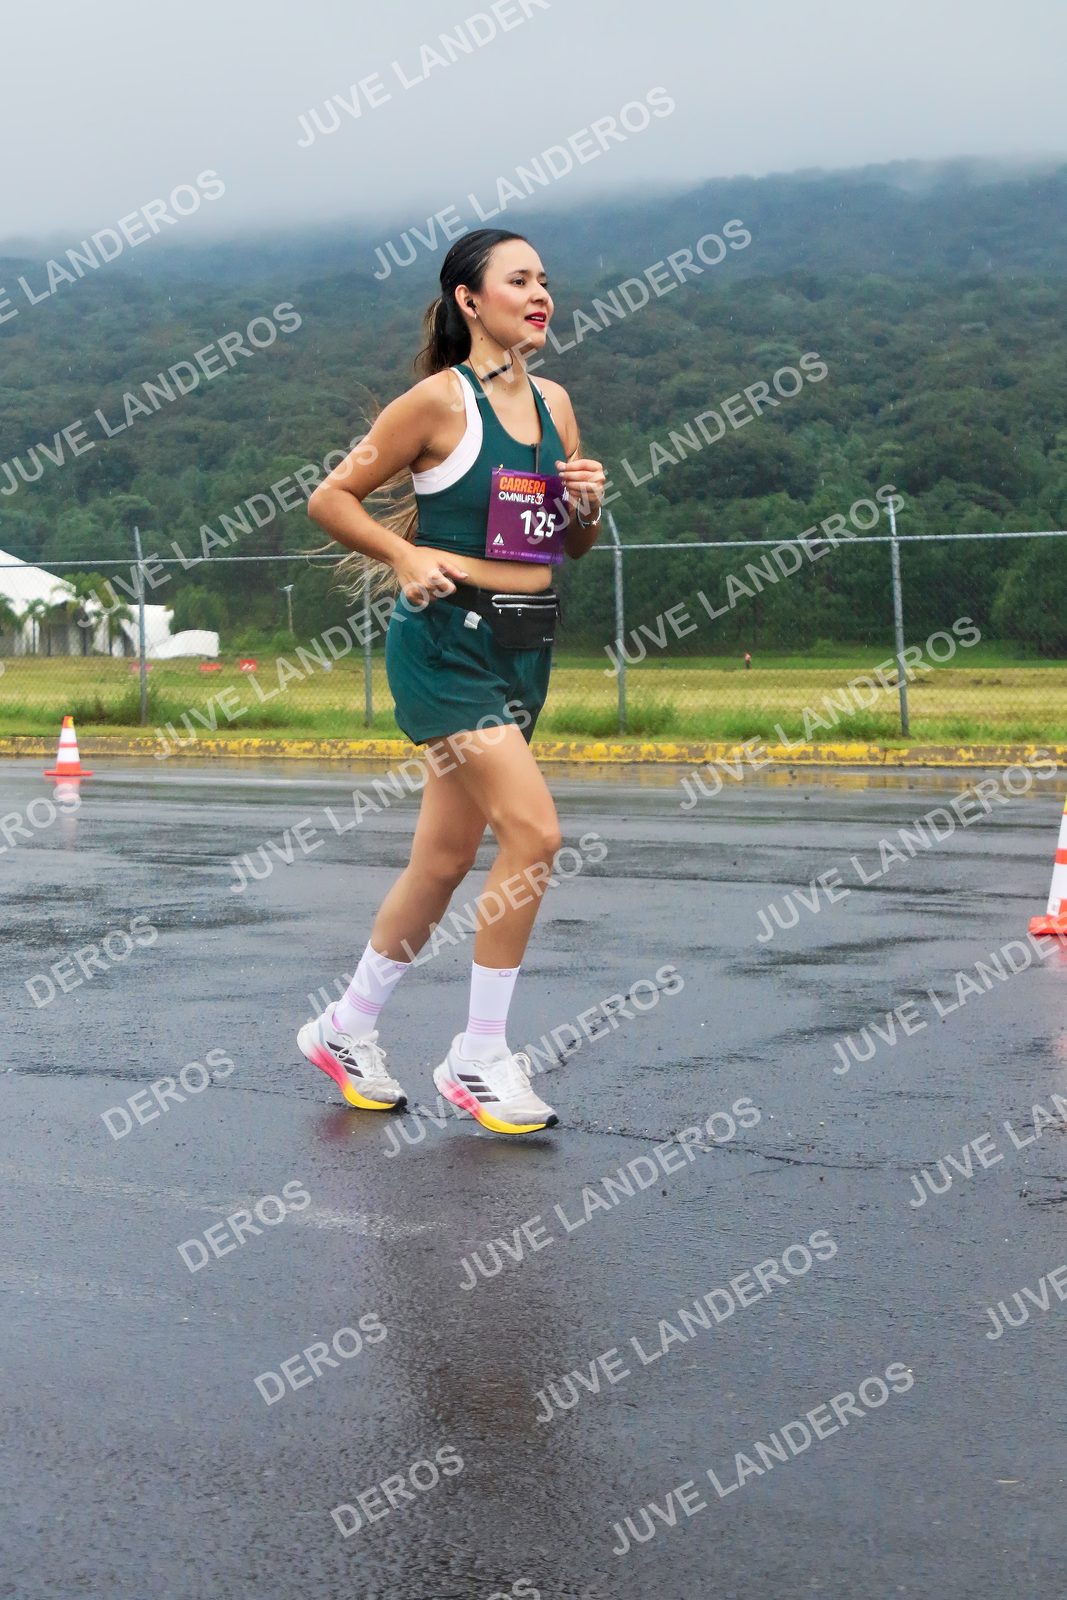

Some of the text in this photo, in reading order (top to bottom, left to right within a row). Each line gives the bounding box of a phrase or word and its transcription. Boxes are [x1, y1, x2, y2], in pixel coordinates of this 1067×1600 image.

[499, 476, 546, 494] CARRERA
[498, 491, 535, 504] OMNILIFE
[520, 510, 556, 538] 125
